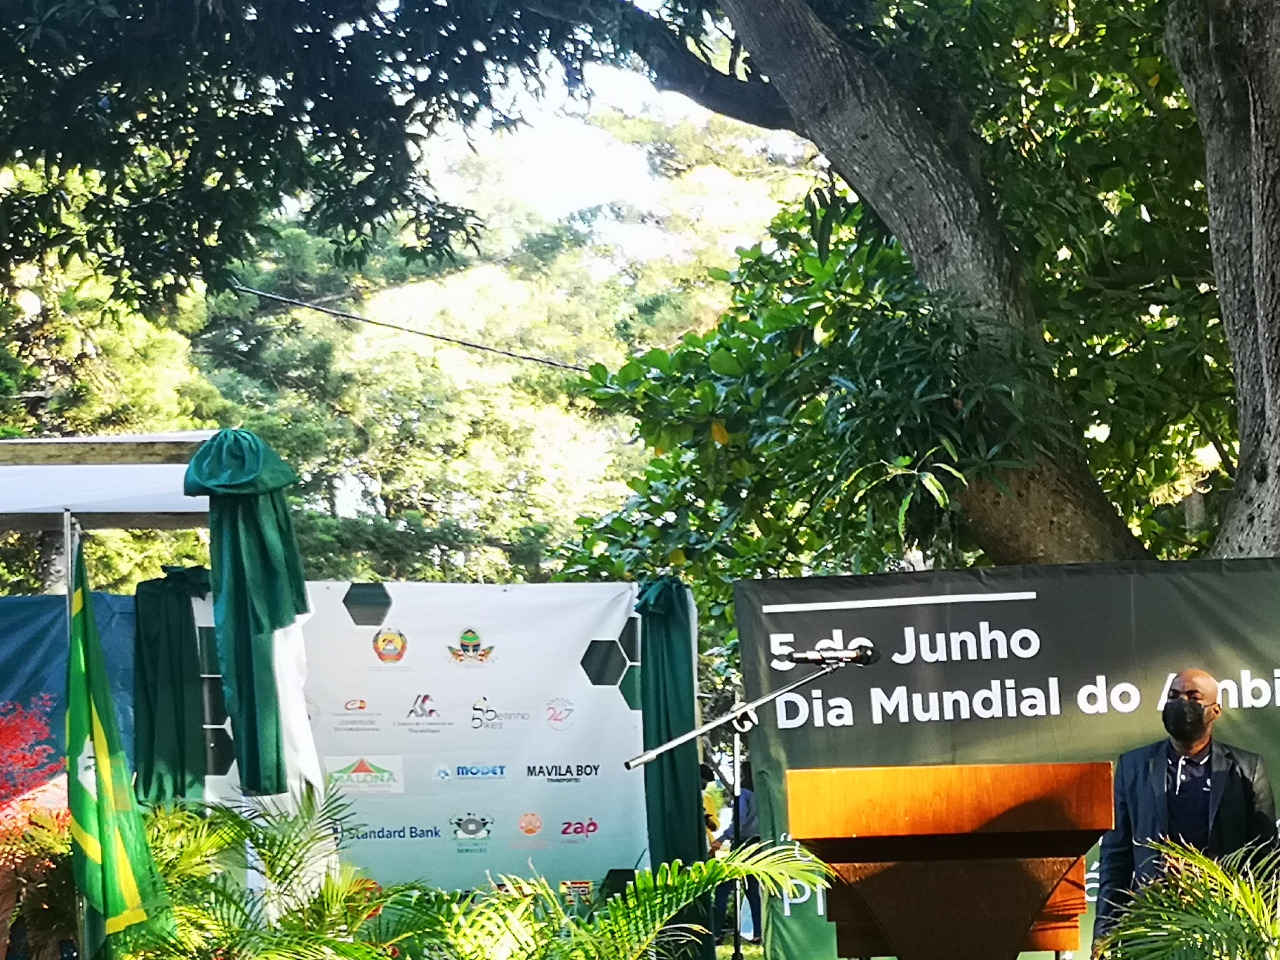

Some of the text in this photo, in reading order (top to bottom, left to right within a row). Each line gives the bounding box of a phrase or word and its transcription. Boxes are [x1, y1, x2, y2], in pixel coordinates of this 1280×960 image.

[769, 633, 797, 671] 5
[892, 621, 1041, 664] Junho
[776, 689, 854, 730] Dia
[871, 676, 1061, 725] Mundial
[1077, 675, 1141, 714] do
[526, 764, 601, 777] MAVILA BOY
[409, 826, 442, 839] Bank
[560, 816, 599, 839] zap
